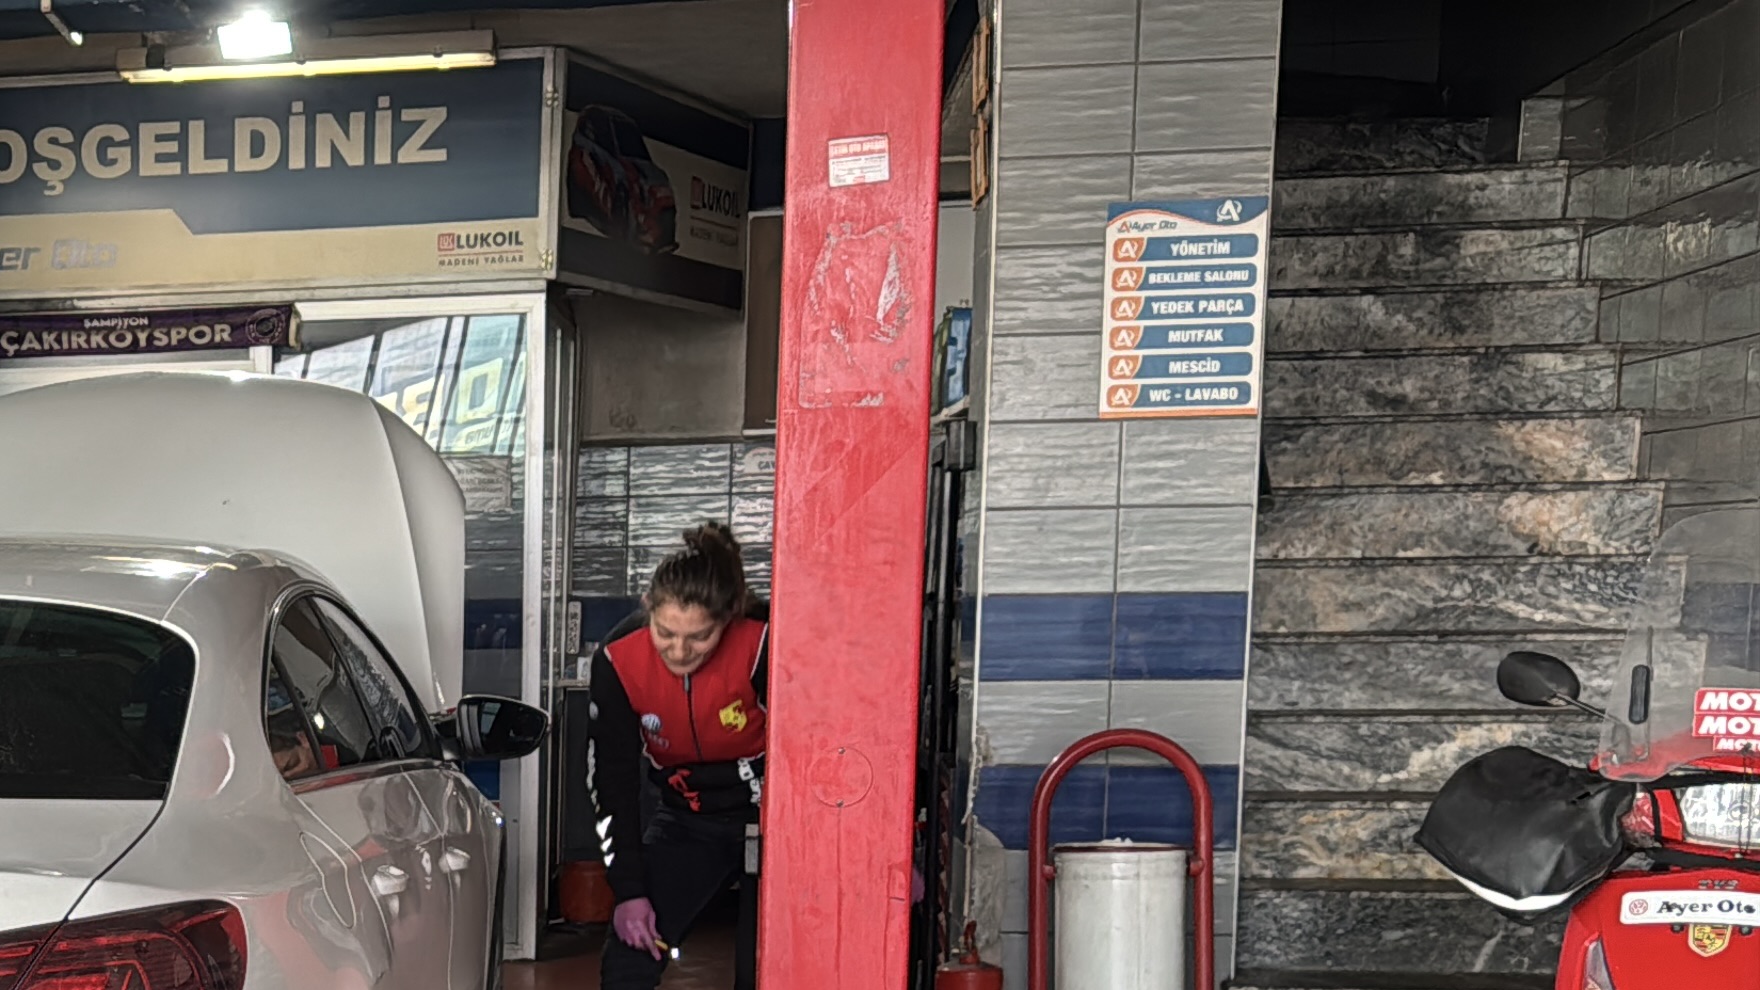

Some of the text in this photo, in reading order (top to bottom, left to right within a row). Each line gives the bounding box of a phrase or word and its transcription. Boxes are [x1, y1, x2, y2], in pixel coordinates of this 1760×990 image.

[456, 230, 524, 249] LUKOIL
[1170, 238, 1231, 256] YÖNETİM
[1148, 270, 1249, 285] BEKLEME SALONU
[1151, 299, 1244, 315] YEDEK PARÇA
[1168, 329, 1224, 343] MUTFAK
[1168, 357, 1221, 374] MESCİD
[1149, 389, 1171, 401] WC
[1185, 387, 1239, 401] LAVABO
[1656, 900, 1714, 916] Ayer
